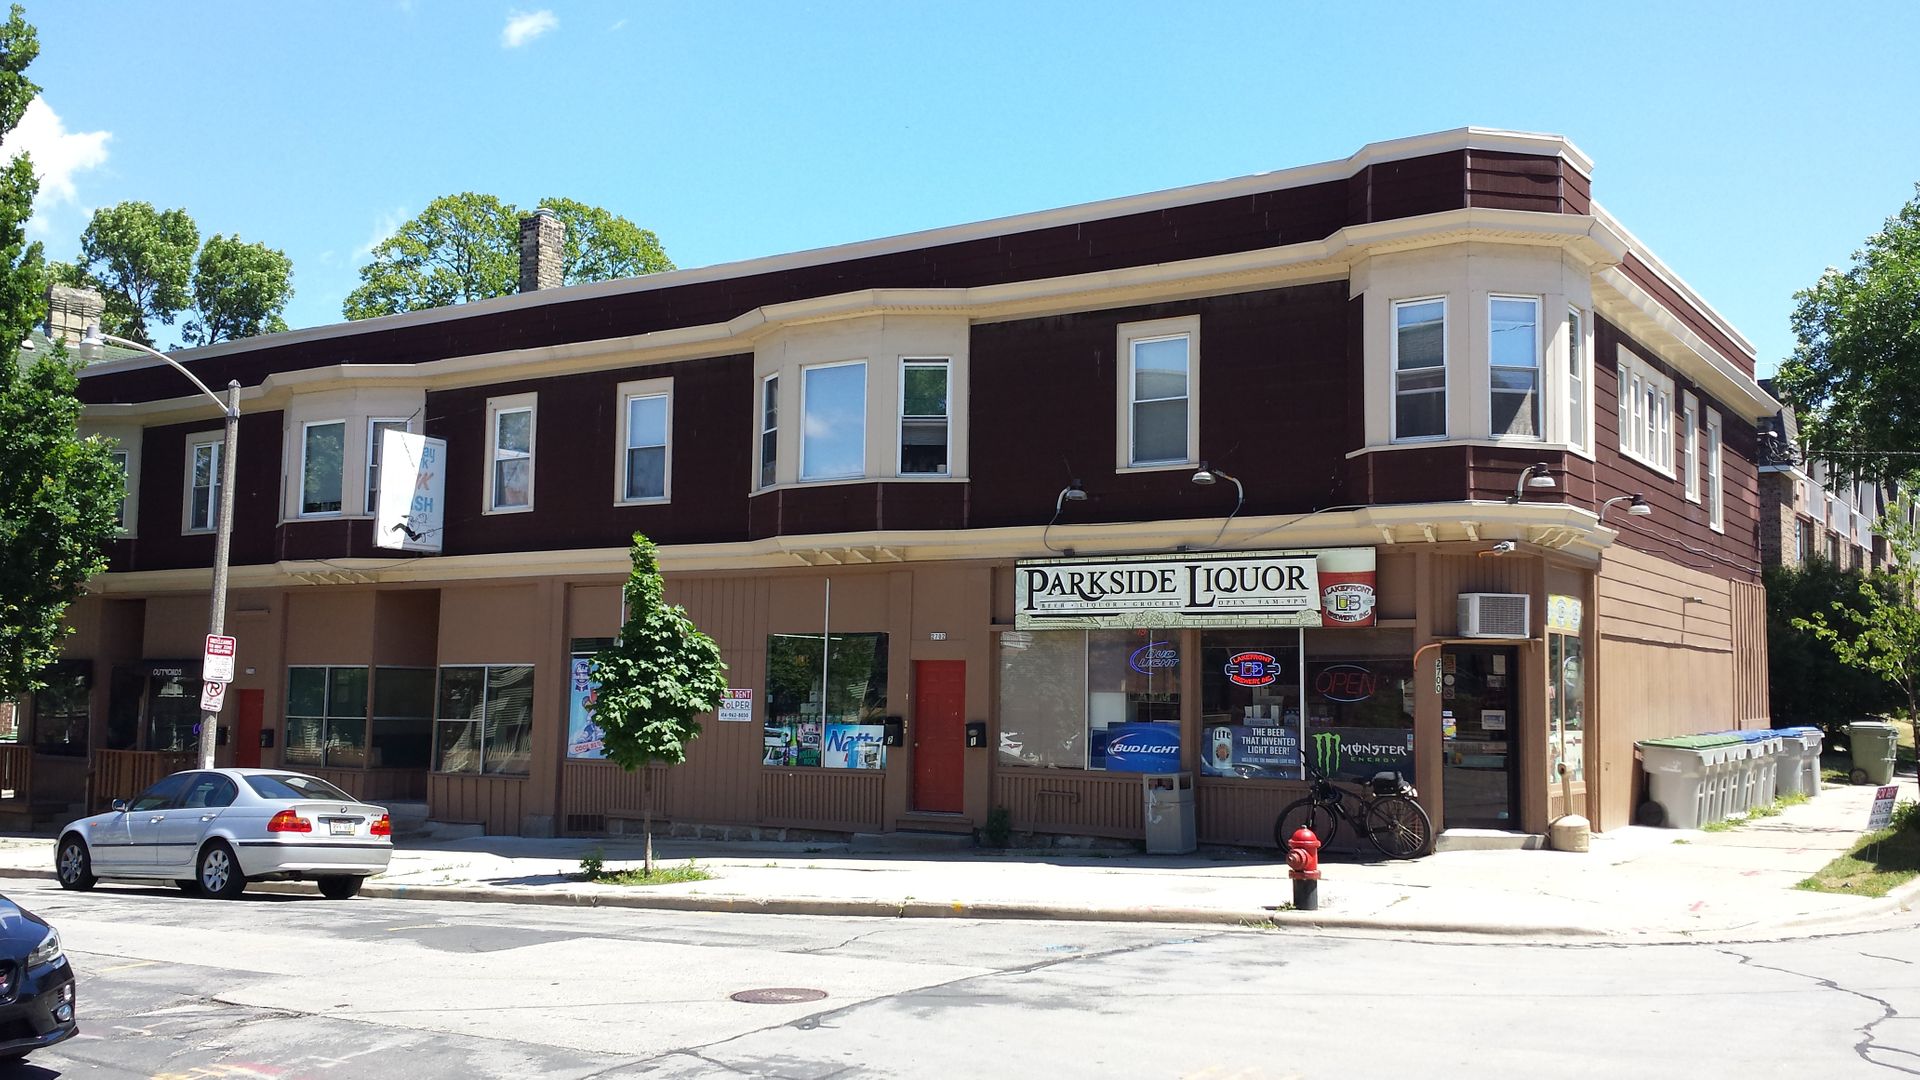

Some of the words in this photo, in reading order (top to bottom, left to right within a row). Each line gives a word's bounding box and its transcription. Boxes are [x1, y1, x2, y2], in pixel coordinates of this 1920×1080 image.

[1023, 568, 1178, 610] PARKSIDE
[1185, 565, 1309, 608] LIQUOR
[1325, 585, 1371, 594] LAKEFRONT
[1080, 601, 1118, 609] LIQUOR
[1132, 600, 1181, 608] GROCERY
[1232, 654, 1273, 663] LAKEFRONT
[1316, 671, 1377, 697] OPEN
[735, 690, 750, 699] RENT
[1252, 727, 1266, 737] THE
[1266, 728, 1285, 738] BEER
[1241, 736, 1260, 746] THAT
[1260, 737, 1296, 747] INVENTED
[1140, 744, 1180, 754] LIGHT
[1247, 745, 1268, 755] LIGHT
[1269, 746, 1290, 756] BEER!
[1340, 742, 1407, 756] MONSTER
